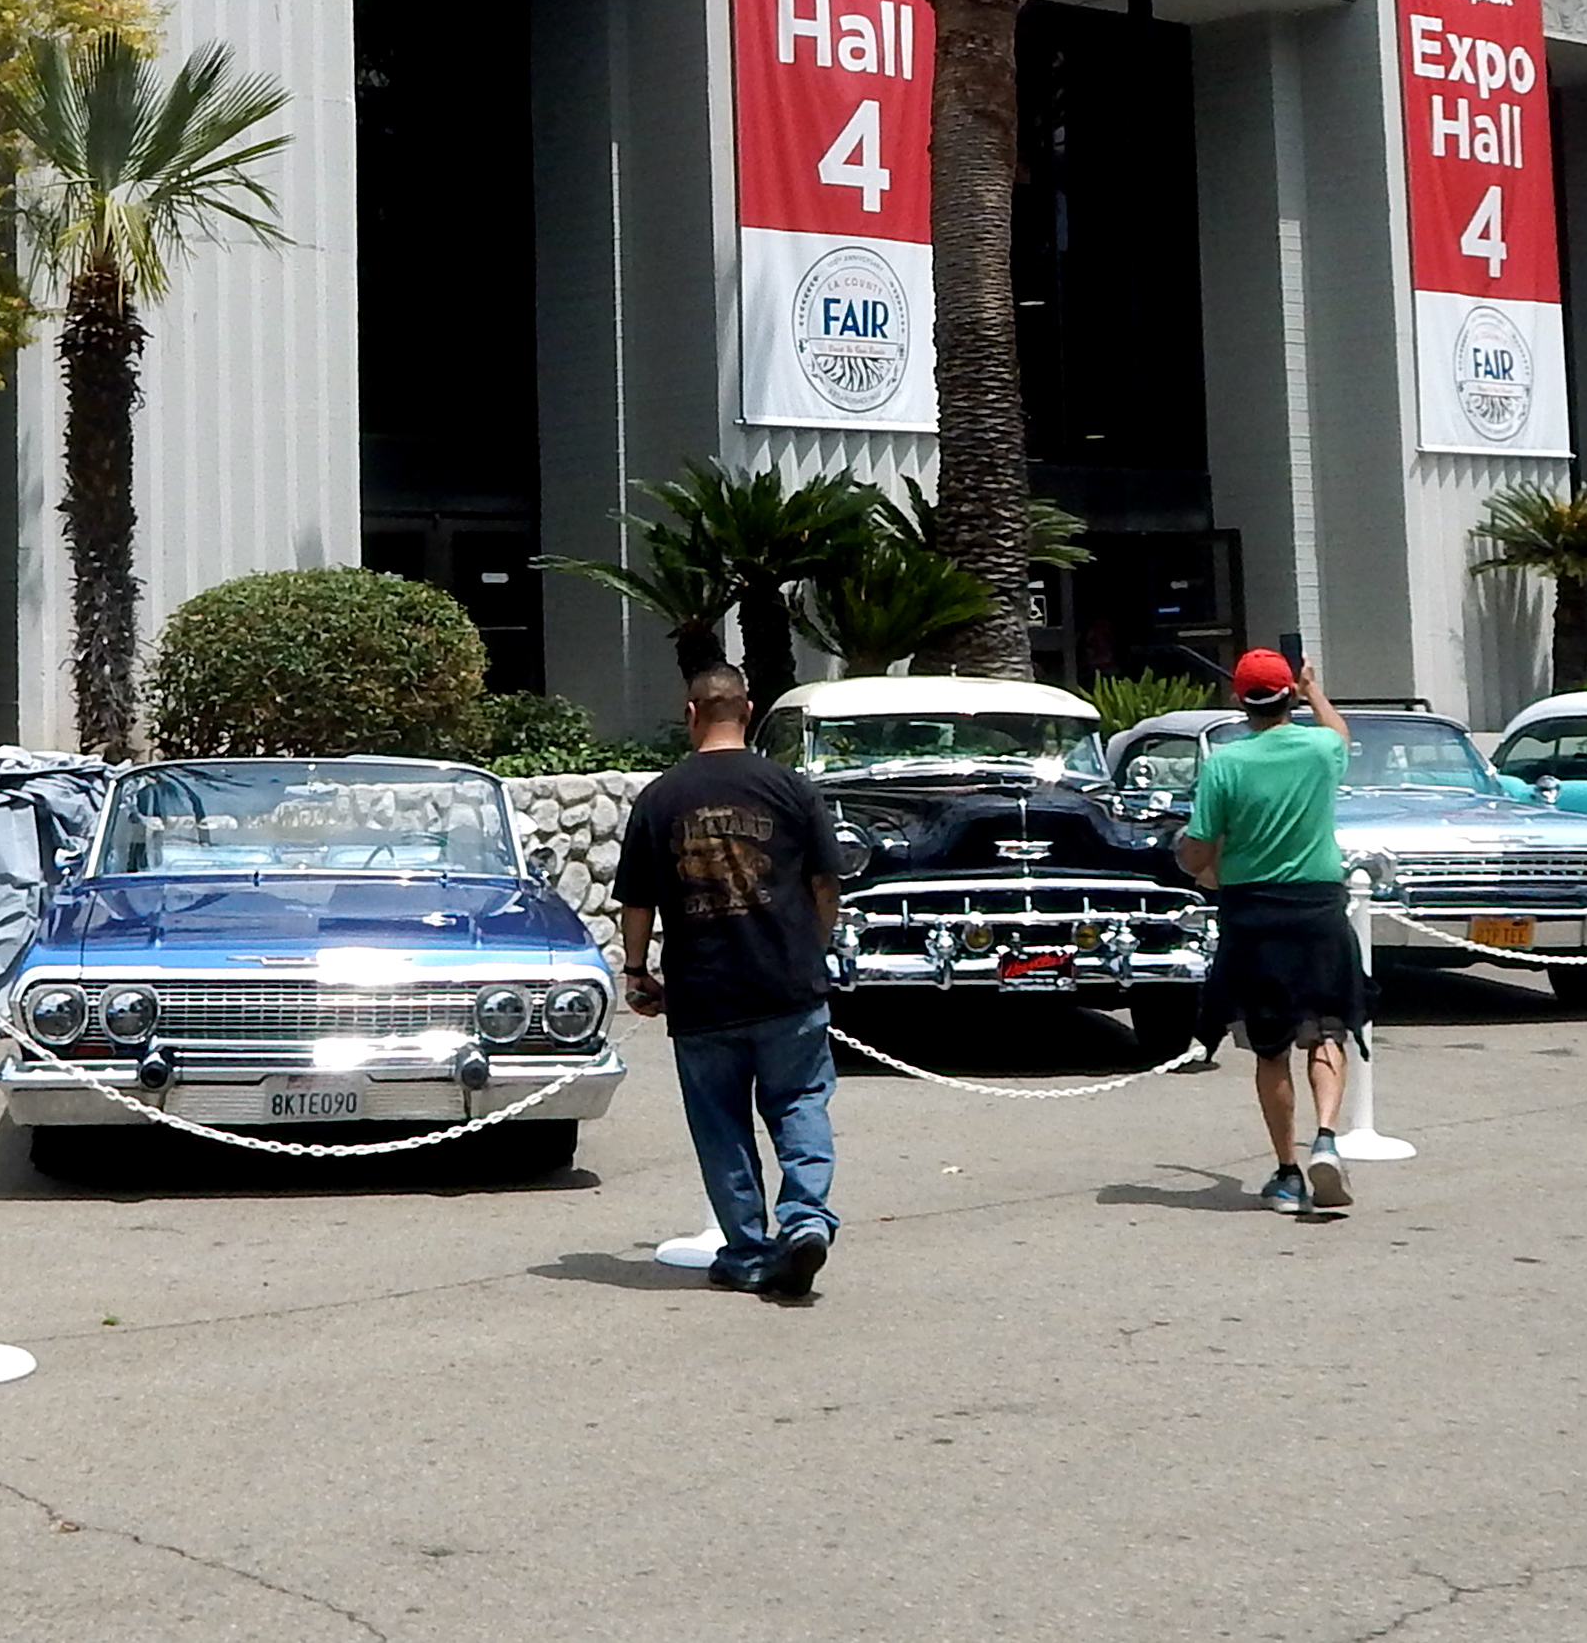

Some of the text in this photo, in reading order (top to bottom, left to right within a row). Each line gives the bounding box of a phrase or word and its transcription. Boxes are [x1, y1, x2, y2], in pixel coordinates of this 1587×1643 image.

[1410, 14, 1536, 99] Expo
[817, 99, 890, 213] 4
[1432, 94, 1523, 169] Hall
[1460, 185, 1508, 279] 4
[823, 297, 889, 339] FAIR
[1472, 347, 1514, 381] FAIR
[272, 1092, 357, 1116] 8KTE090
